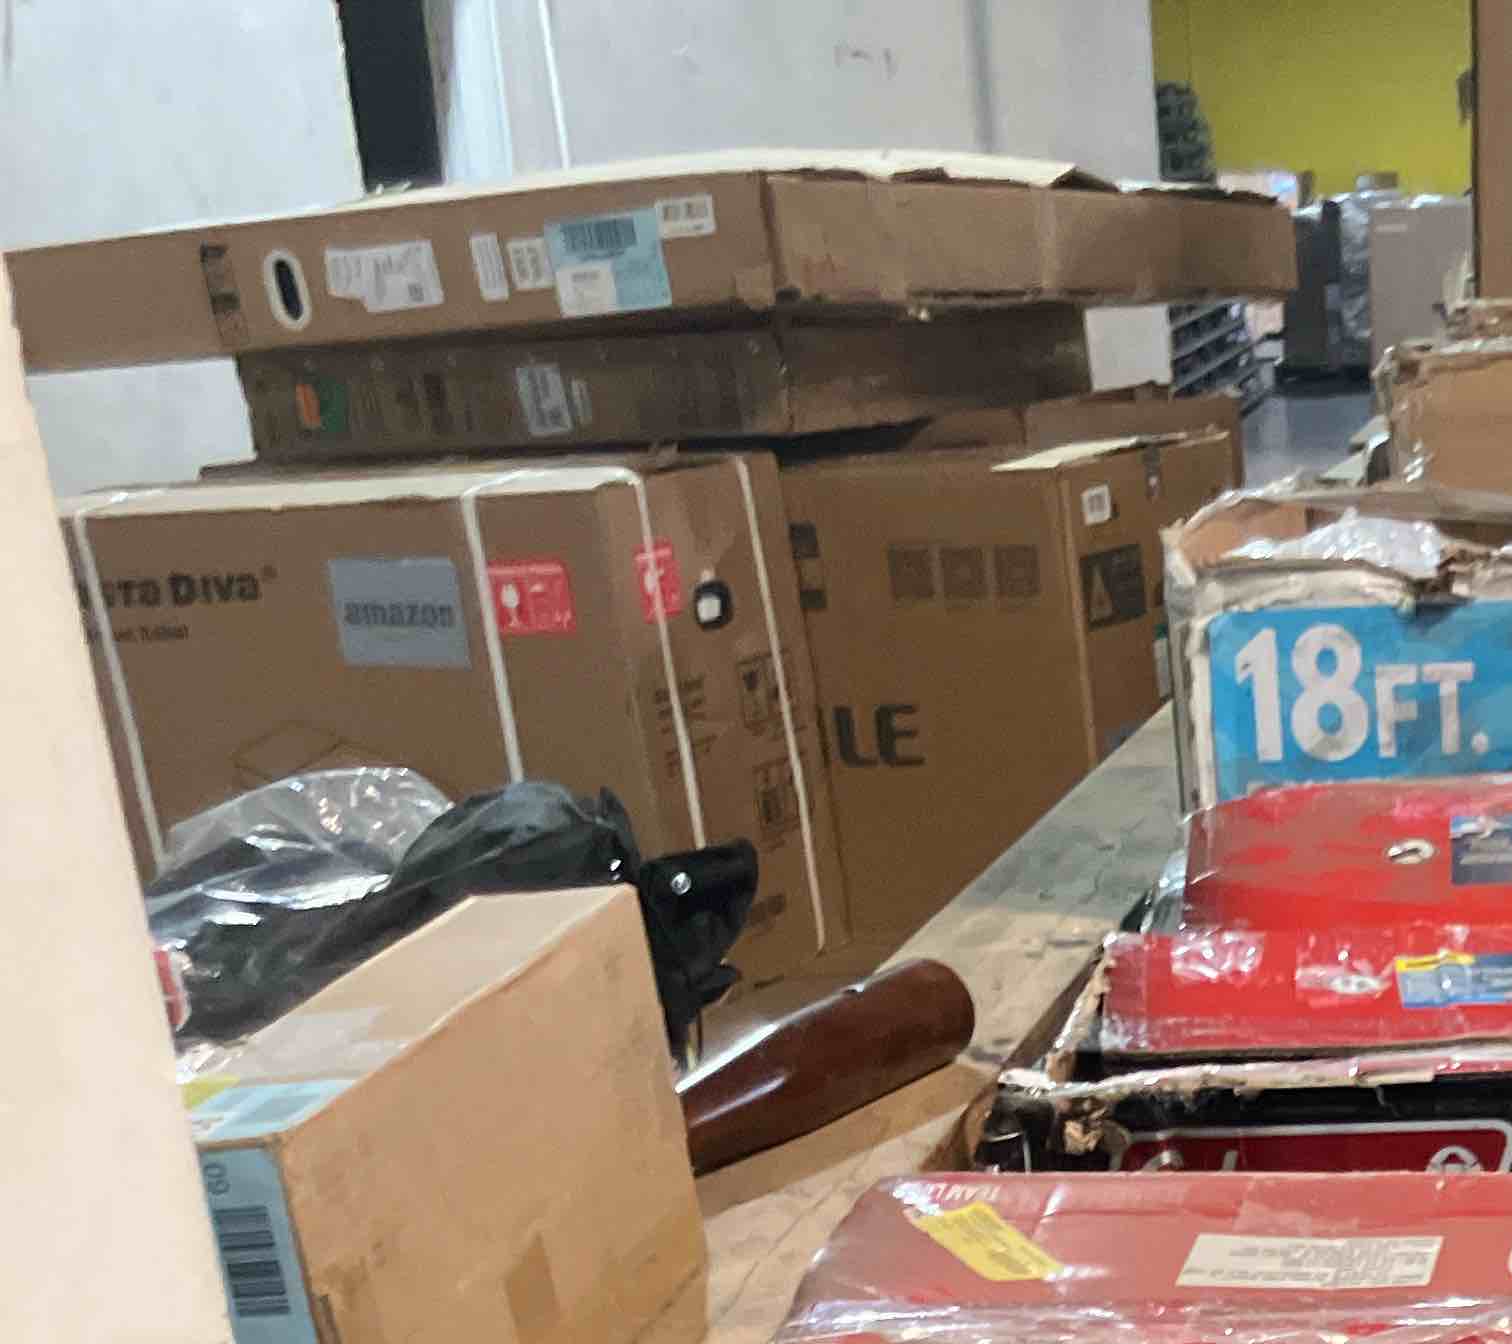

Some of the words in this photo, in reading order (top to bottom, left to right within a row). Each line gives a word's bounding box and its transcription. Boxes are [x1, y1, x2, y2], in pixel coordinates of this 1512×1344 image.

[343, 602, 454, 627] amazon
[1235, 623, 1369, 763] 18
[1374, 660, 1489, 760] FT.
